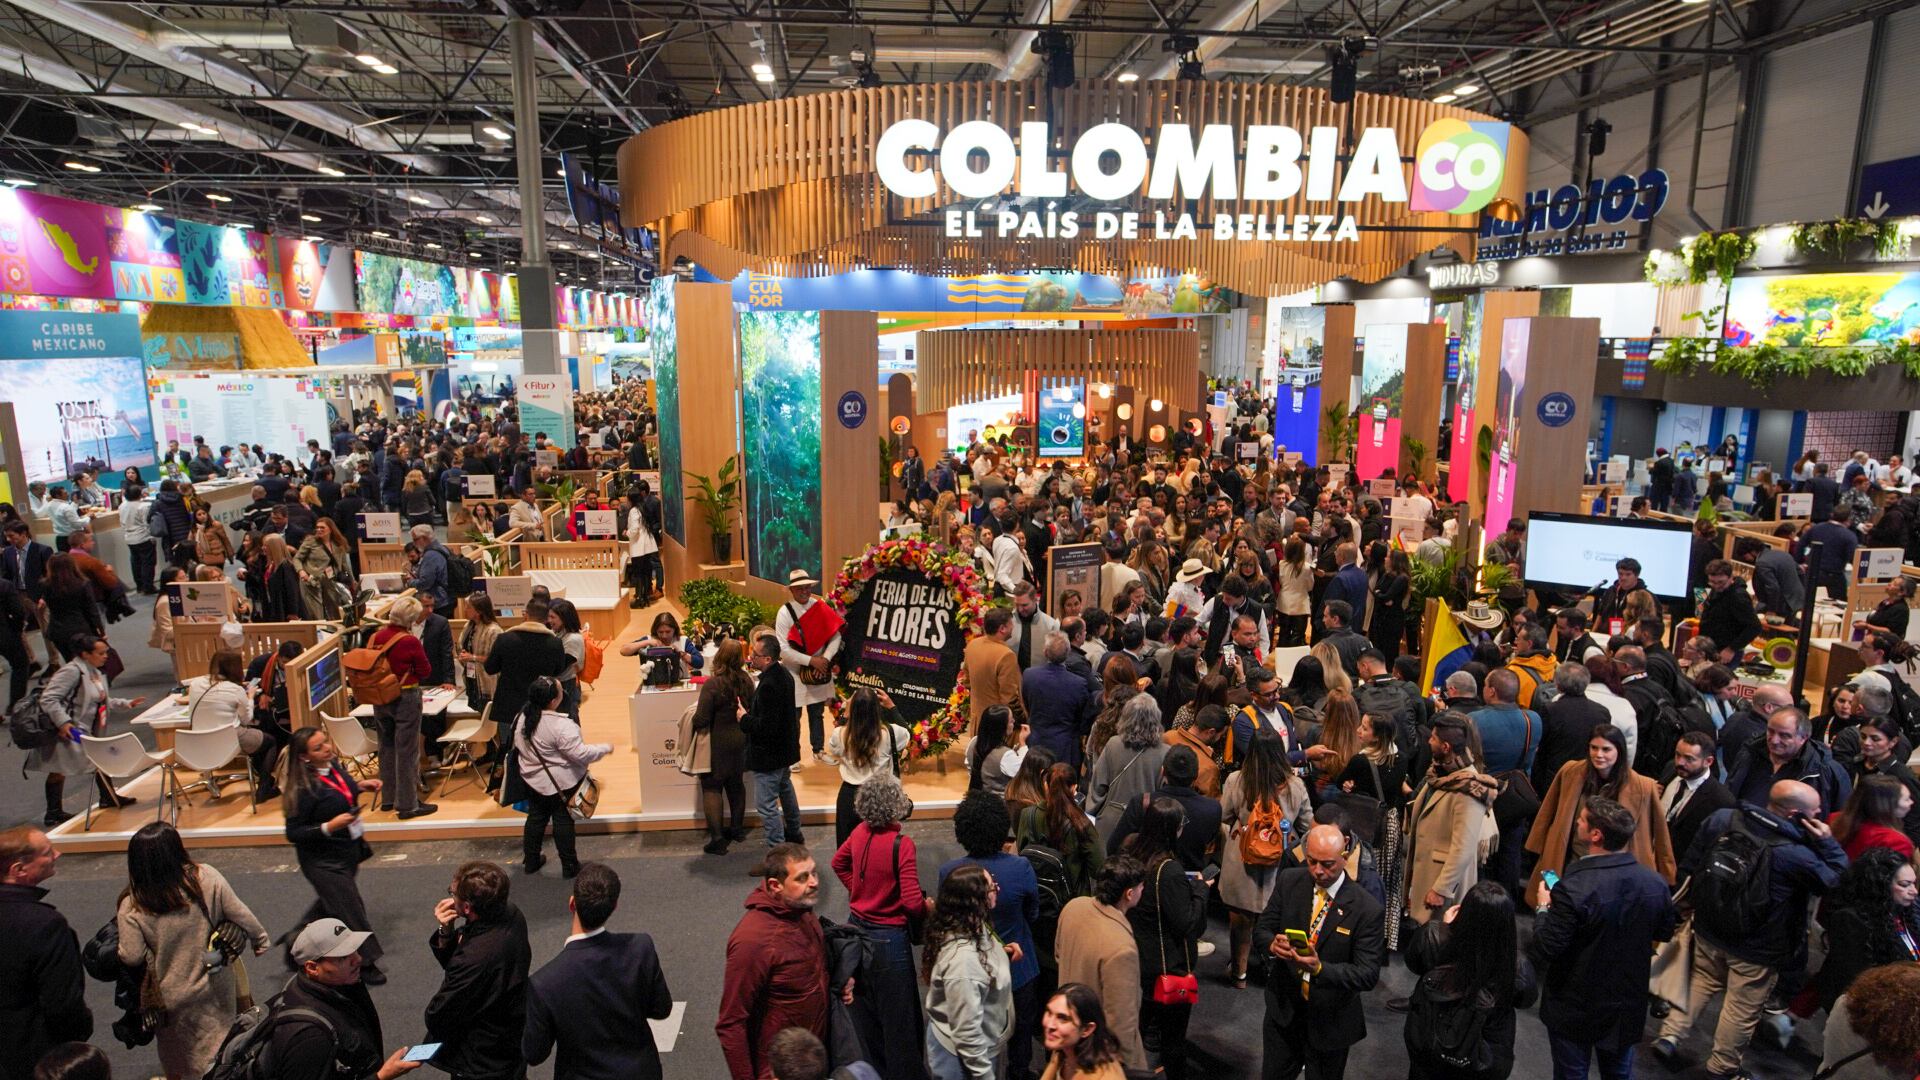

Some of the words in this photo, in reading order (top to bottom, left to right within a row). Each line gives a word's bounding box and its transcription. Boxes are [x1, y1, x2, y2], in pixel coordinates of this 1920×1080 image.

[876, 118, 1408, 203] COLOMBIA
[1419, 140, 1502, 192] CO
[945, 210, 982, 238] EL
[998, 202, 1079, 238] PAÍS
[1095, 212, 1139, 239] DE
[1155, 212, 1197, 240] LA
[1213, 213, 1360, 242] BELLEZA
[749, 281, 783, 294] CUA
[749, 294, 783, 307] DOR
[41, 323, 94, 336] CARIBE
[32, 338, 106, 351] MEXICANO
[844, 401, 861, 414] CO
[1545, 401, 1568, 414] CO
[169, 596, 181, 604] 35
[873, 579, 908, 606] FERIA
[909, 584, 929, 605] DE
[928, 586, 954, 610] LAS
[866, 601, 950, 649] FLORES
[845, 671, 884, 688] Medellín
[895, 688, 907, 697] PAÍS
